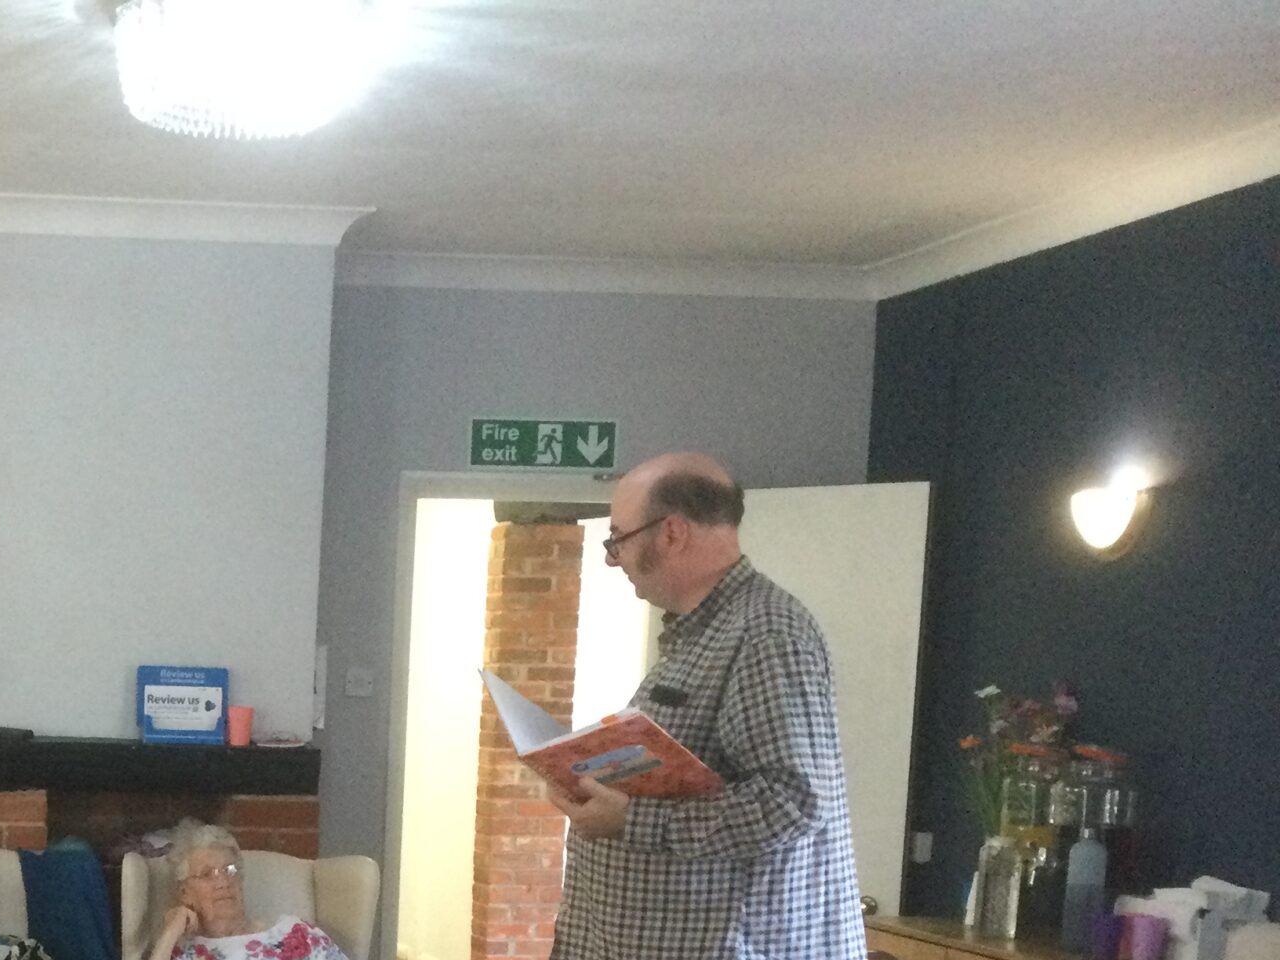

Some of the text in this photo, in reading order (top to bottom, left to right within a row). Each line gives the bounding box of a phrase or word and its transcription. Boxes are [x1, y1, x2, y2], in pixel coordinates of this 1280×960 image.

[481, 423, 520, 441] Fire
[482, 445, 518, 462] exit
[160, 669, 193, 679] Review
[147, 694, 200, 705] Review us
